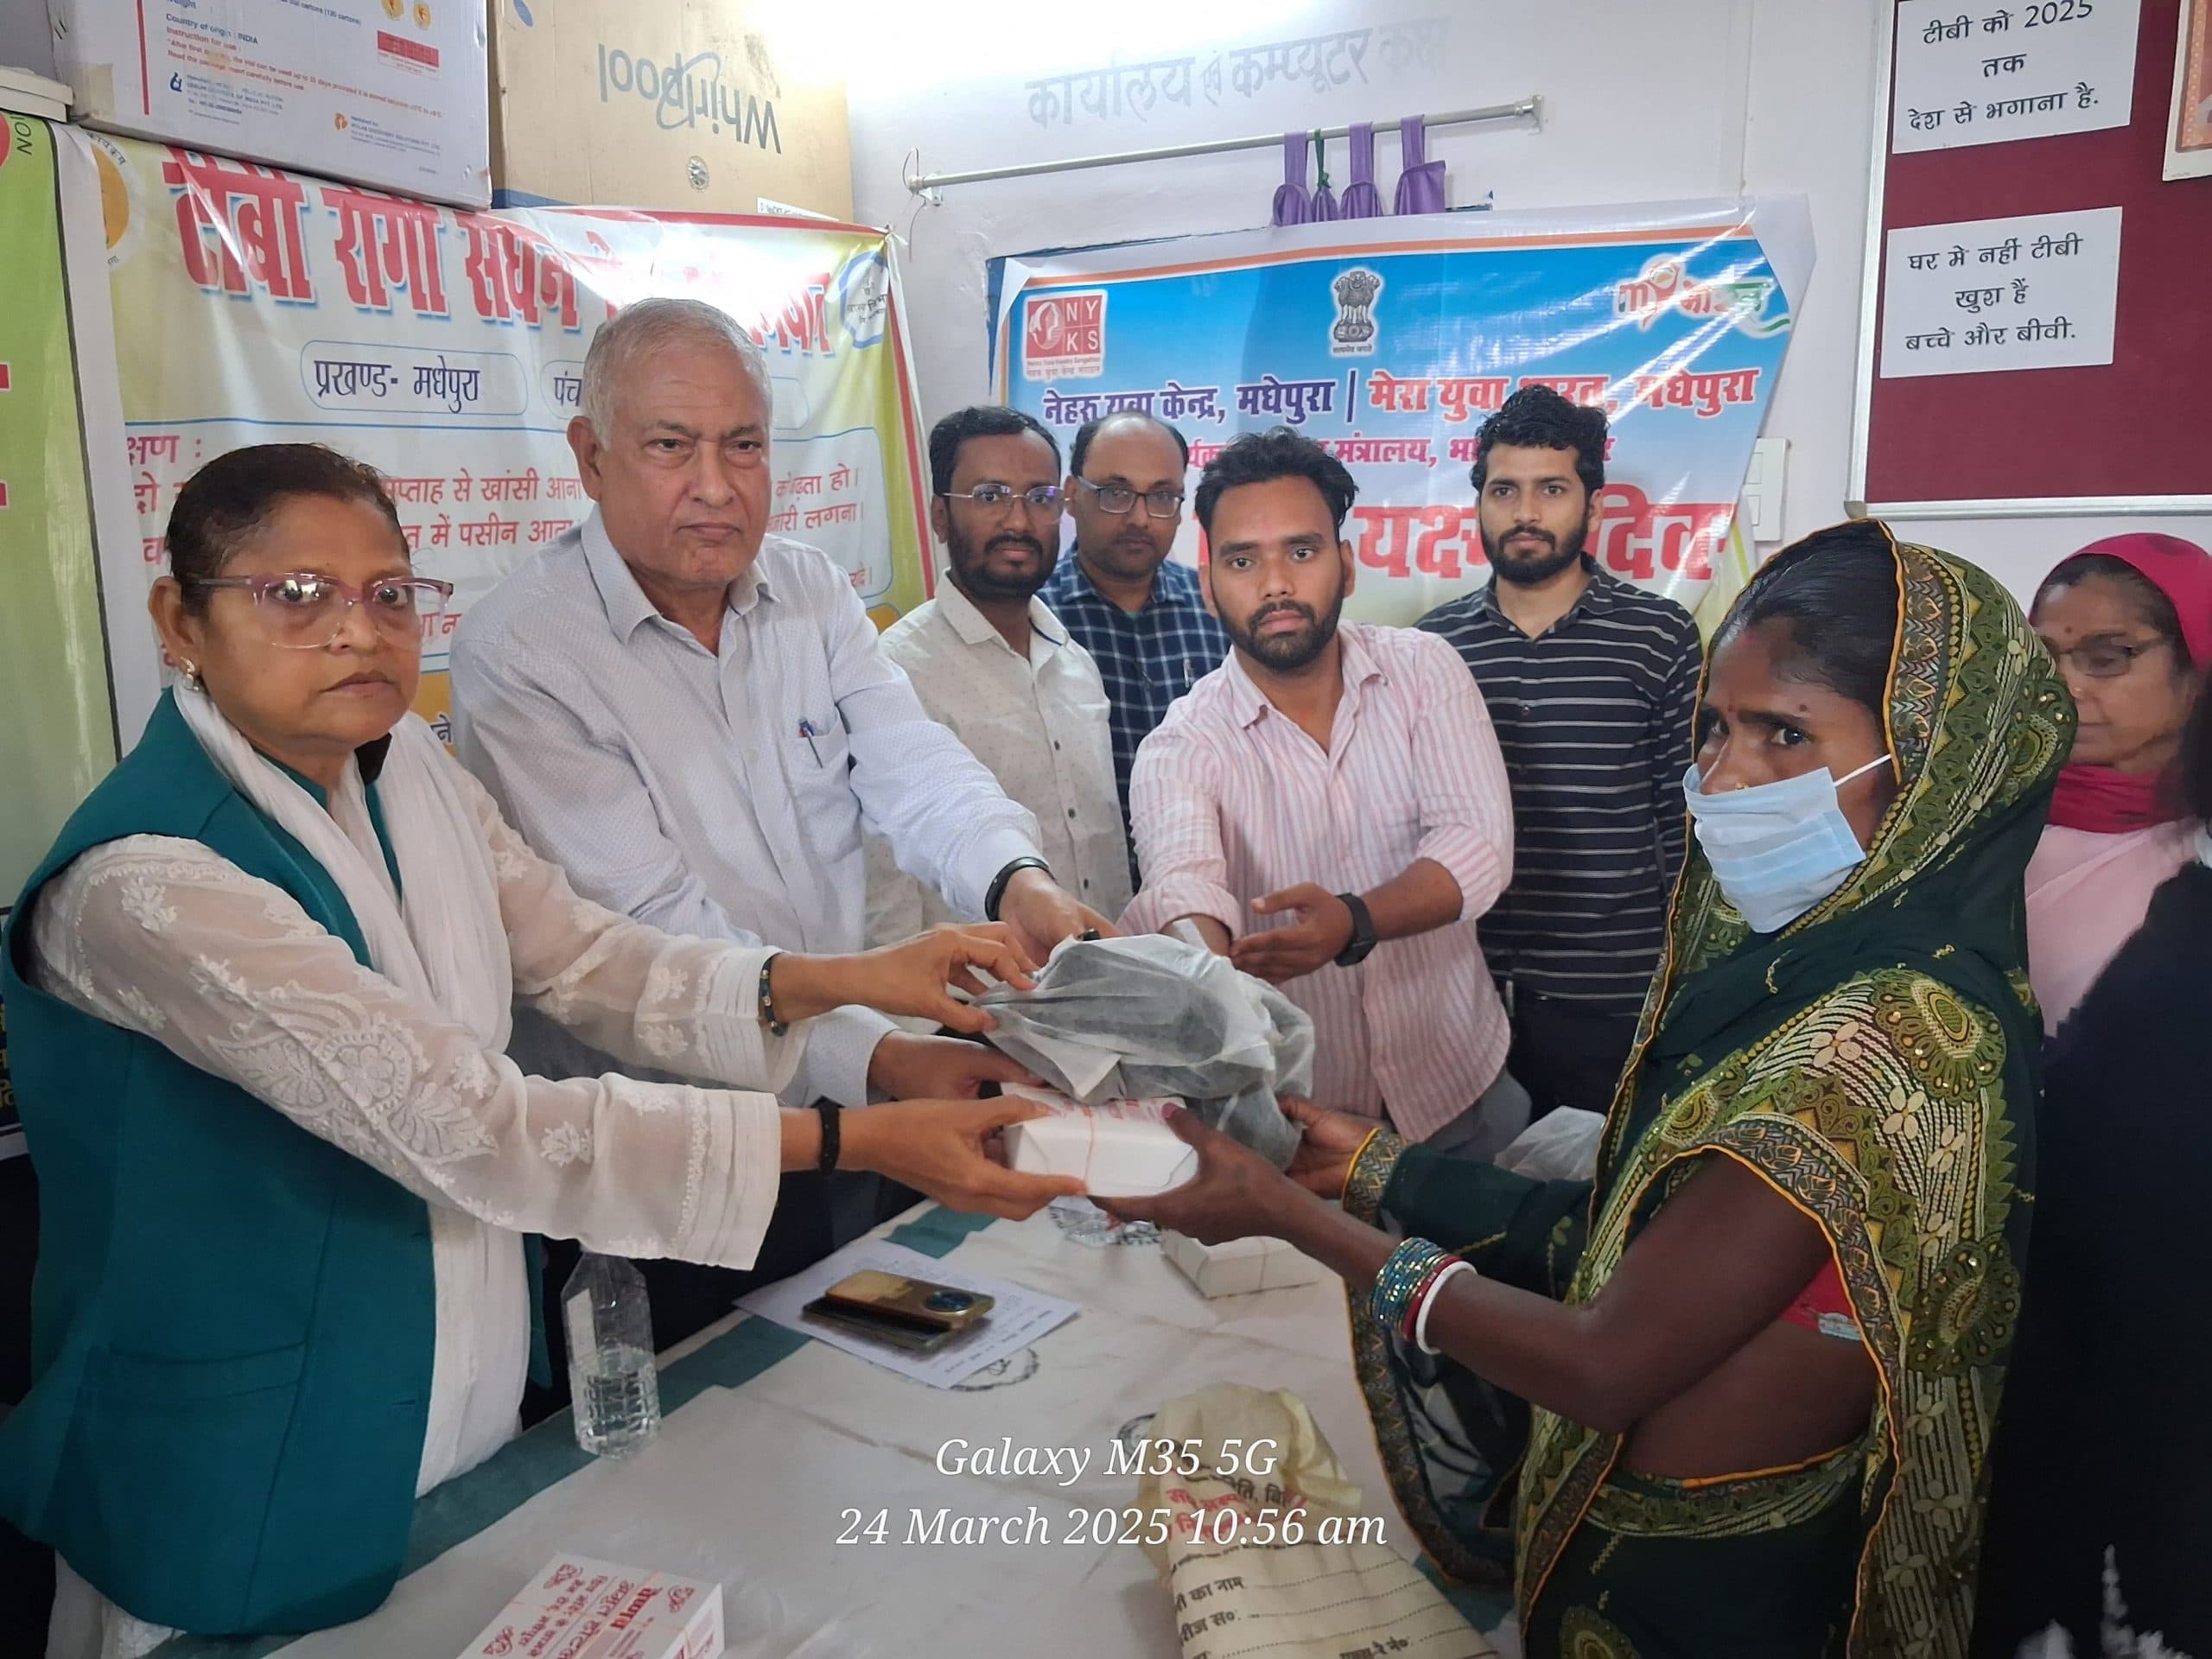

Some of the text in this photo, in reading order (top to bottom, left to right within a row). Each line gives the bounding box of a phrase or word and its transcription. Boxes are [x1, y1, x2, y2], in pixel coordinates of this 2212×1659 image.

[166, 13, 198, 29] Country
[238, 33, 258, 44] INDIA
[166, 27, 209, 43] Instruction
[211, 37, 222, 48] for
[1923, 0, 2093, 45] टीबी को 2025
[1981, 54, 2027, 79] तक
[598, 43, 782, 155] Whirlpool
[1908, 107, 1944, 130] देश
[1954, 101, 1978, 125] से
[1986, 92, 2069, 121] भगाना
[1907, 252, 1941, 270] घर
[1977, 238, 2023, 265] नहीं
[2031, 232, 2084, 259] टीबी
[1955, 277, 2030, 314] खुश हैं
[1904, 327, 1956, 351] बच्चे
[1964, 321, 2009, 347] और
[413, 355, 480, 414] मधेपुरा
[1236, 375, 1336, 423] मधेपुरा
[1367, 371, 1431, 413] मेरा
[1437, 378, 1509, 420] युवा
[1335, 433, 1438, 467] मंत्रालय,
[453, 467, 473, 502] से
[480, 467, 540, 501] खांसी
[430, 512, 451, 548] में
[1214, 1575, 1245, 1592] नाम
